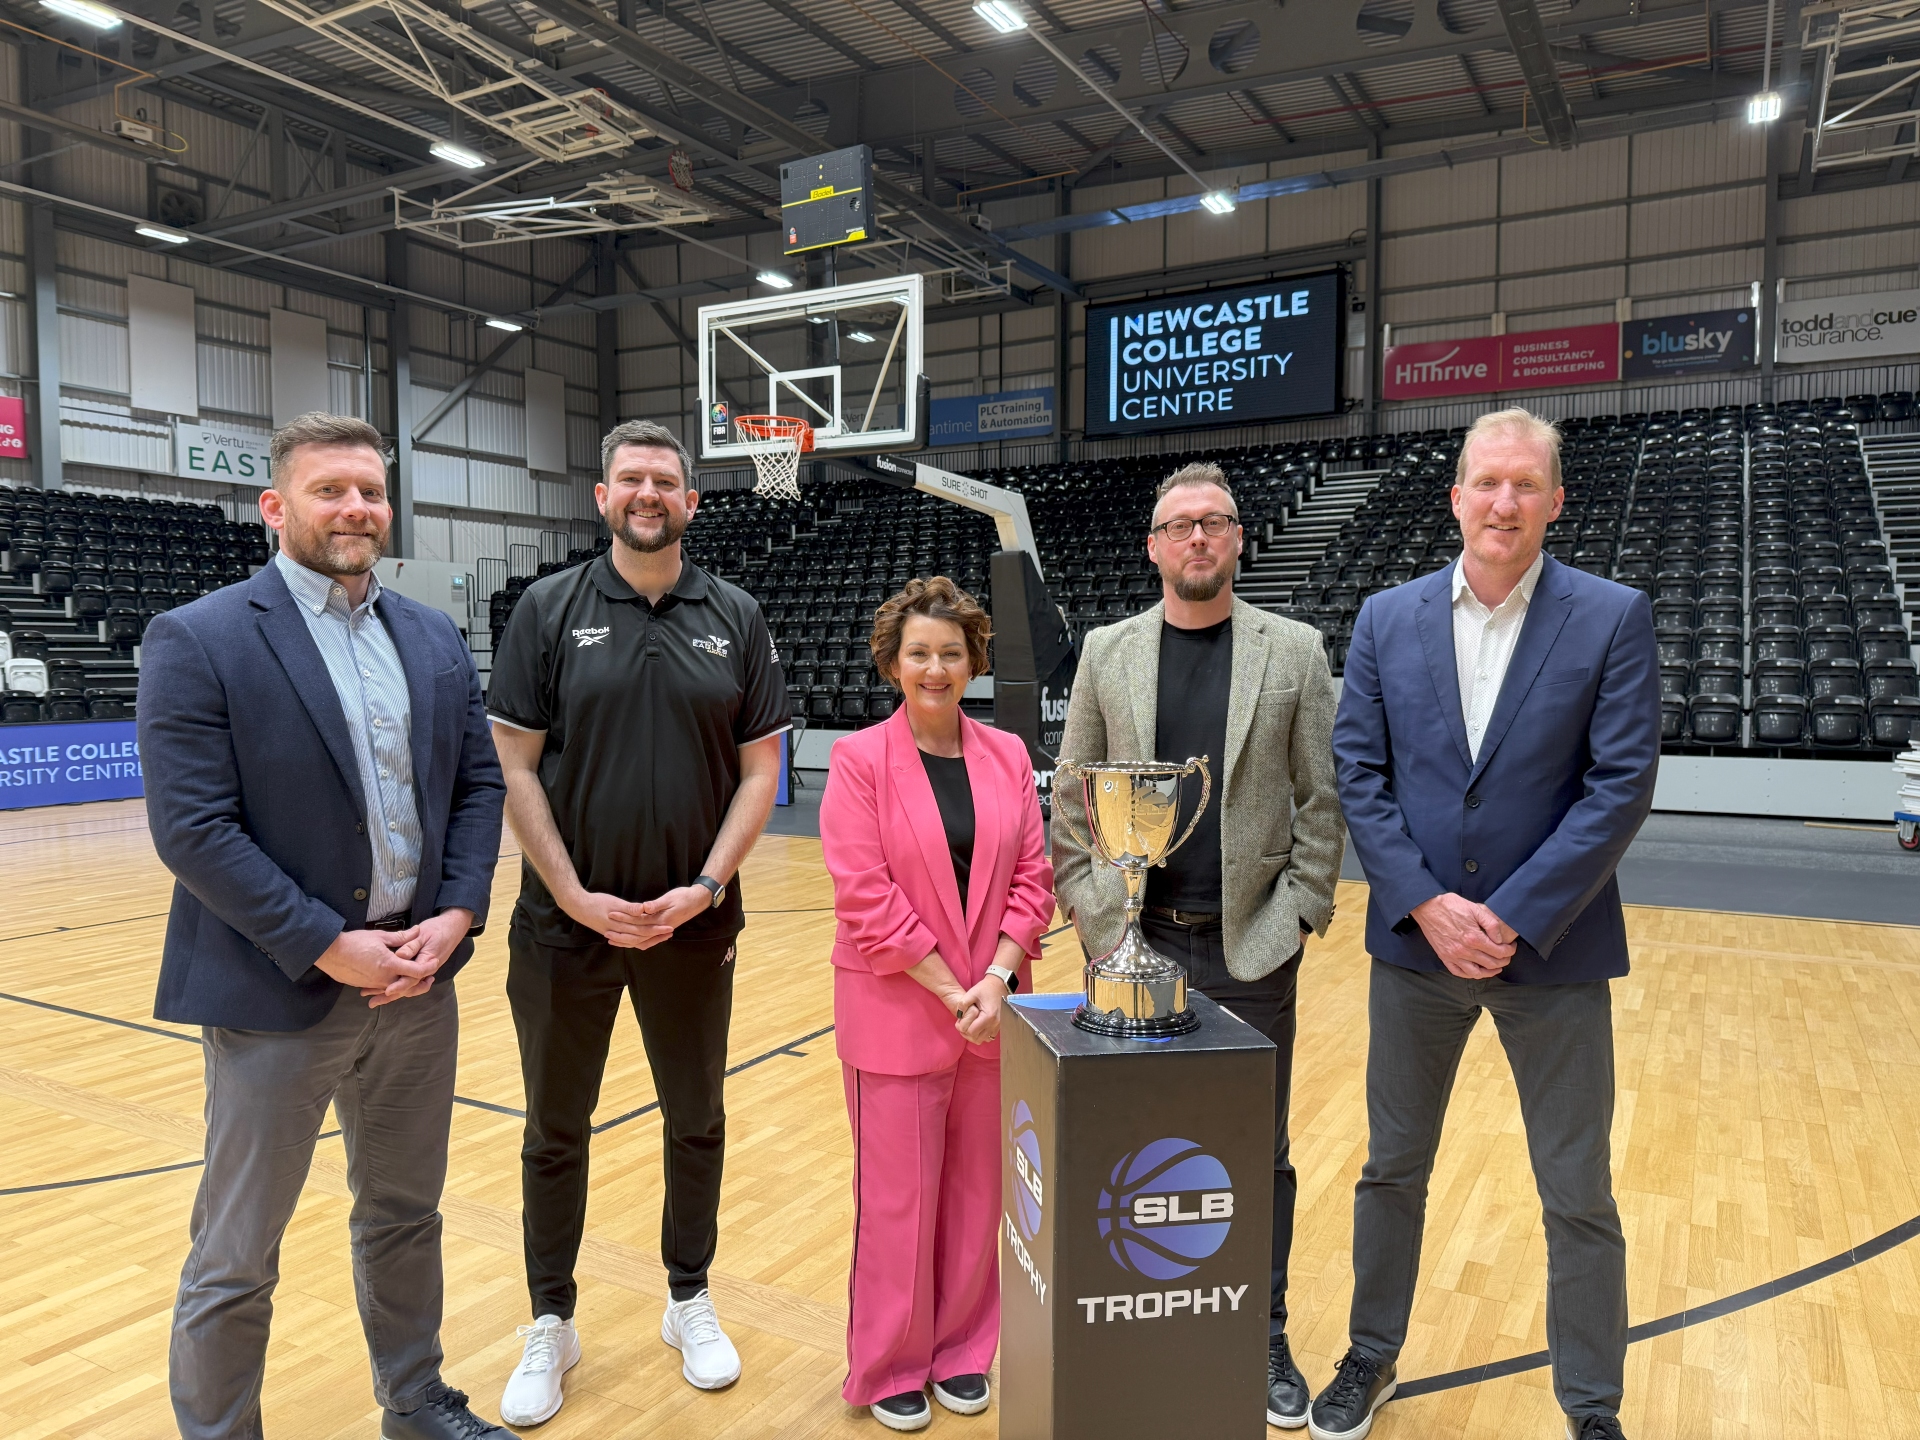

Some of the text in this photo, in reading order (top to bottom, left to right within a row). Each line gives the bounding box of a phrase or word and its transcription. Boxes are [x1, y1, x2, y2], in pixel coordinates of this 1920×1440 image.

[1124, 290, 1310, 338] NEWCASTLE
[1122, 326, 1262, 366] COLLEGE
[1513, 340, 1570, 353] BUSINESS
[1642, 327, 1733, 355] blusky
[1782, 326, 1883, 349] insurance.
[1395, 347, 1488, 385] HiThrive
[1513, 350, 1595, 366] CONSULTANCY
[1513, 361, 1605, 377] & BOOKKEEPING
[1123, 351, 1293, 393] UNIVERSITY
[980, 401, 1041, 416] PLC Training
[1122, 387, 1233, 421] CENTRE
[713, 426, 726, 435] FIBA
[980, 414, 1050, 429] & Automation
[213, 433, 244, 449] Vertu
[188, 446, 271, 479] EAST
[877, 455, 896, 472] fusion
[941, 476, 988, 500] SURE SHOT
[572, 626, 610, 637] Reebok
[0, 767, 60, 787] RSITY
[1016, 1146, 1042, 1206] SLB
[1134, 1192, 1234, 1224] SLB
[1005, 1211, 1047, 1305] TROPHY
[1077, 1284, 1249, 1324] TROPHY
